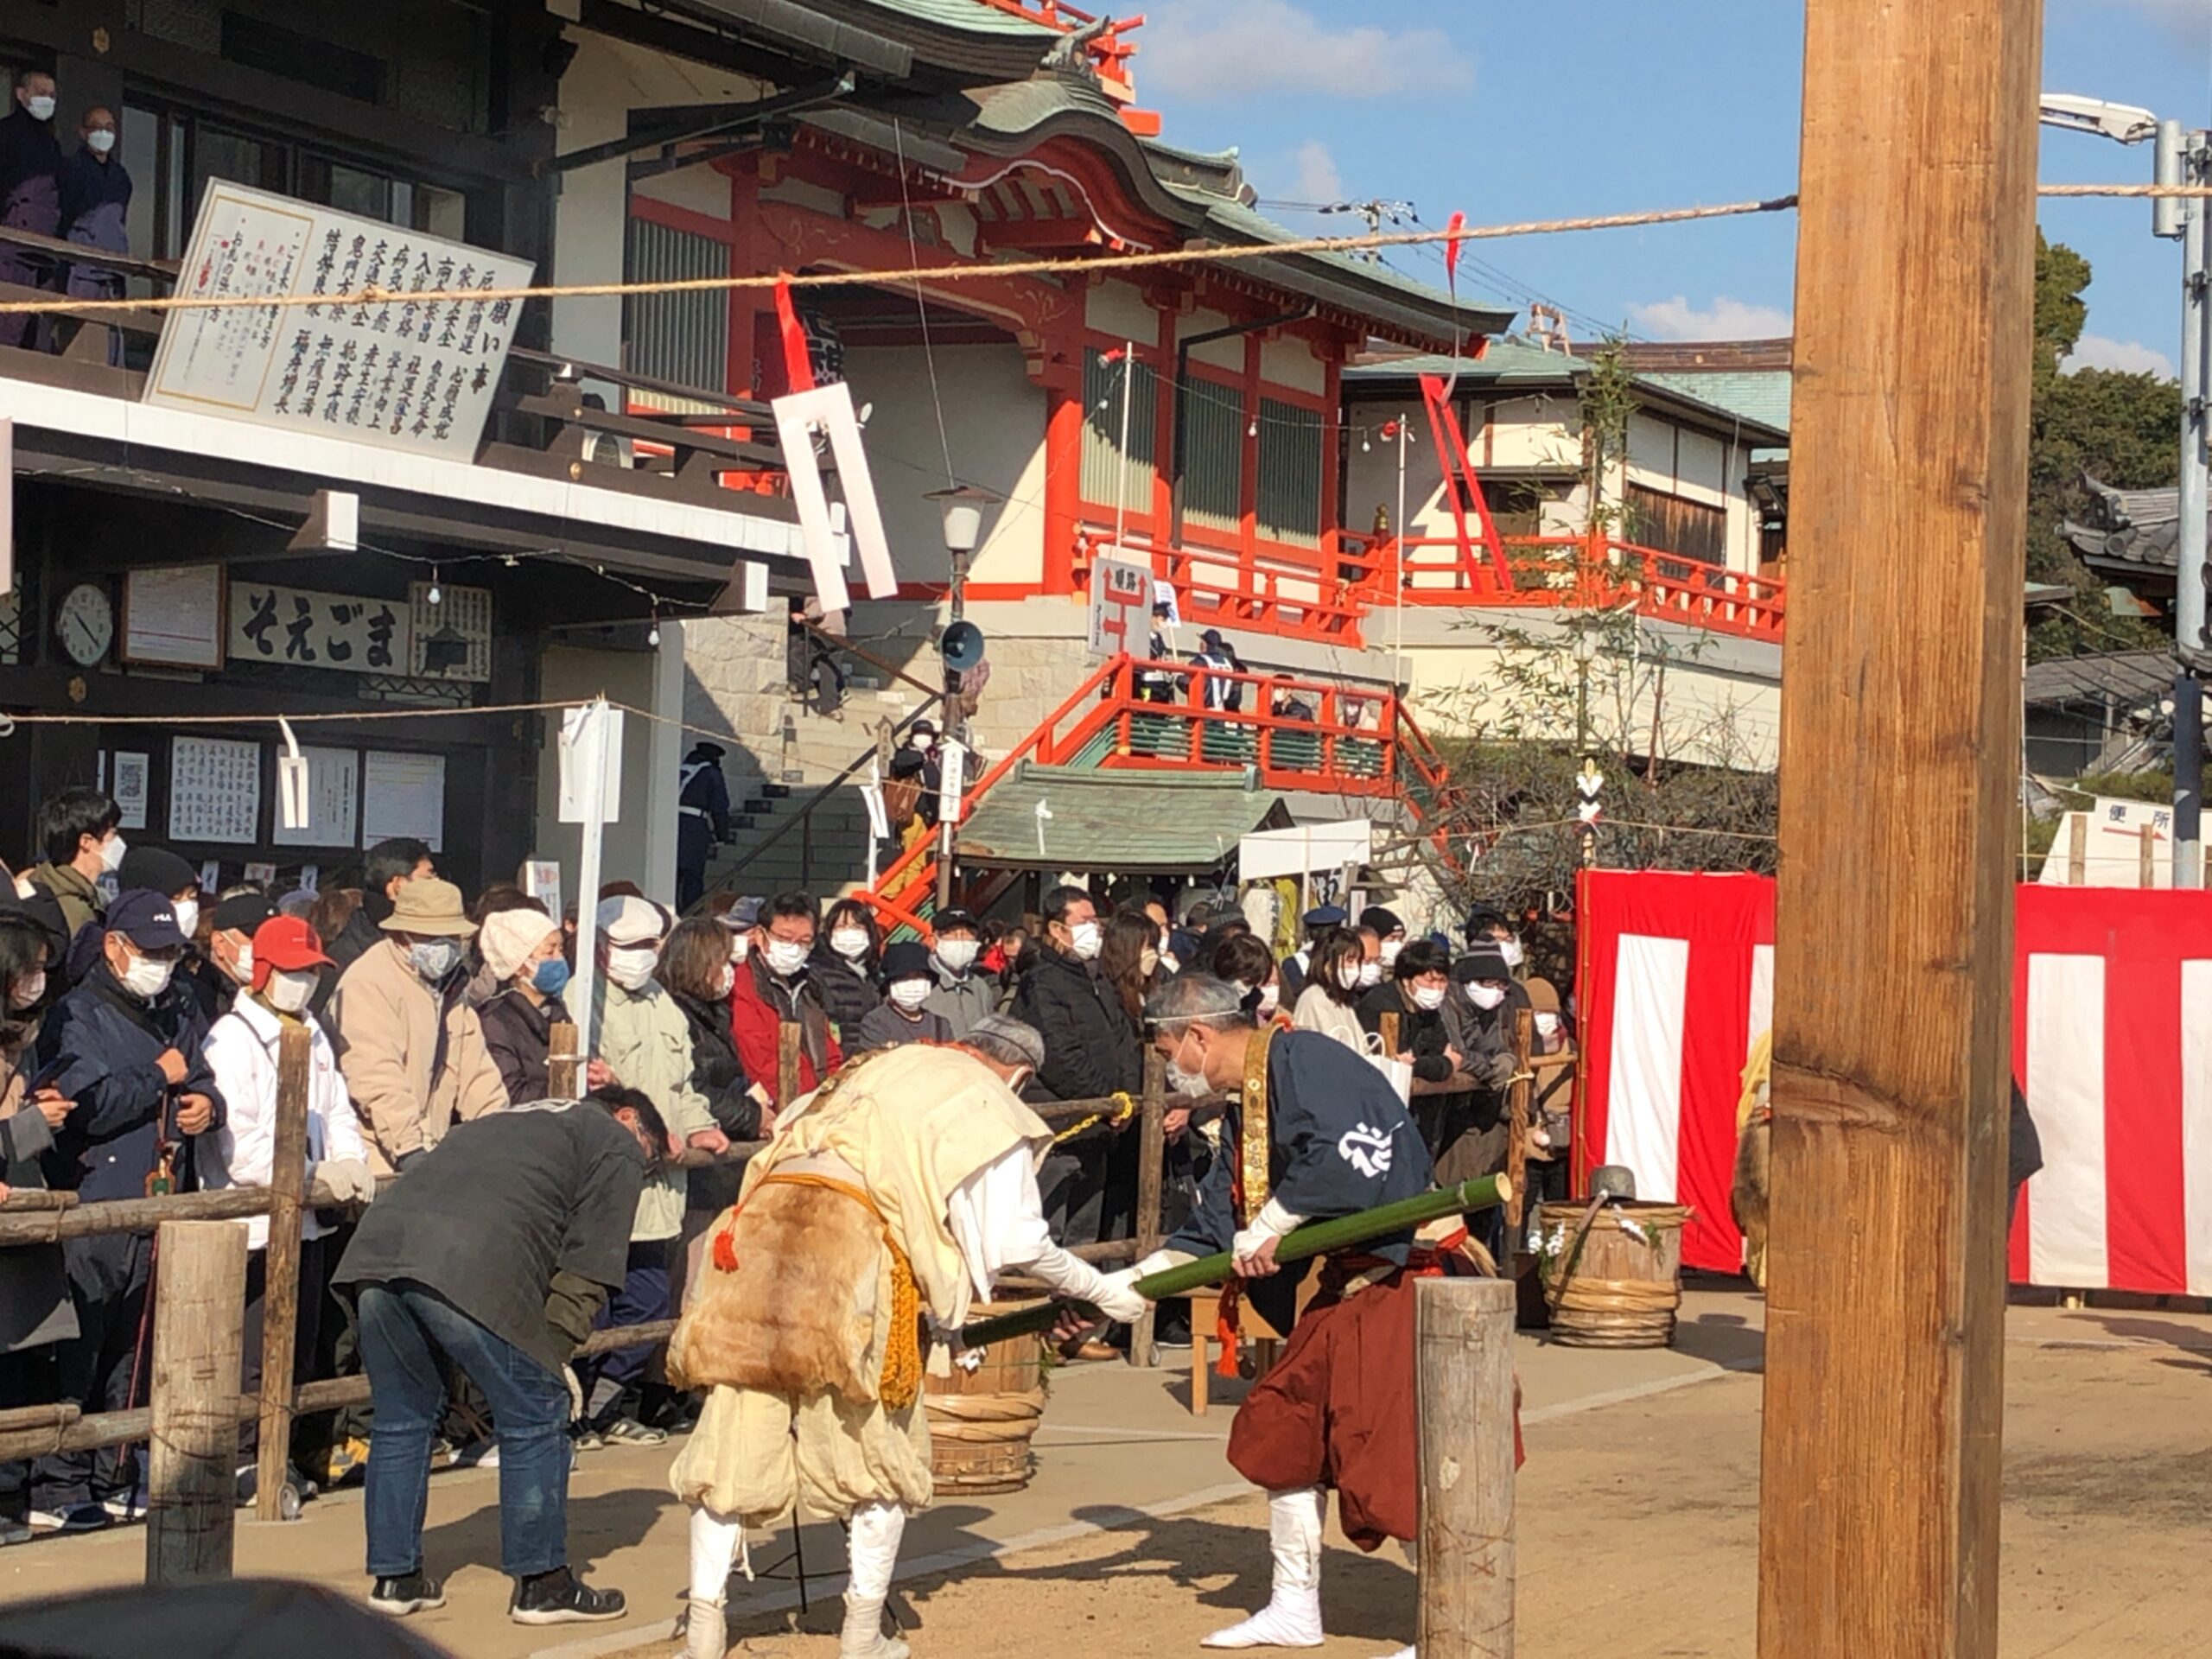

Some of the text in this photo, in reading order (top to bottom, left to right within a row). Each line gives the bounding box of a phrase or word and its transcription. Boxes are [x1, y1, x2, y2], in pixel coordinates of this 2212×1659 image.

[351, 238, 388, 327] 交通全
[242, 588, 397, 667] そえごま
[2108, 804, 2171, 830] 便所
